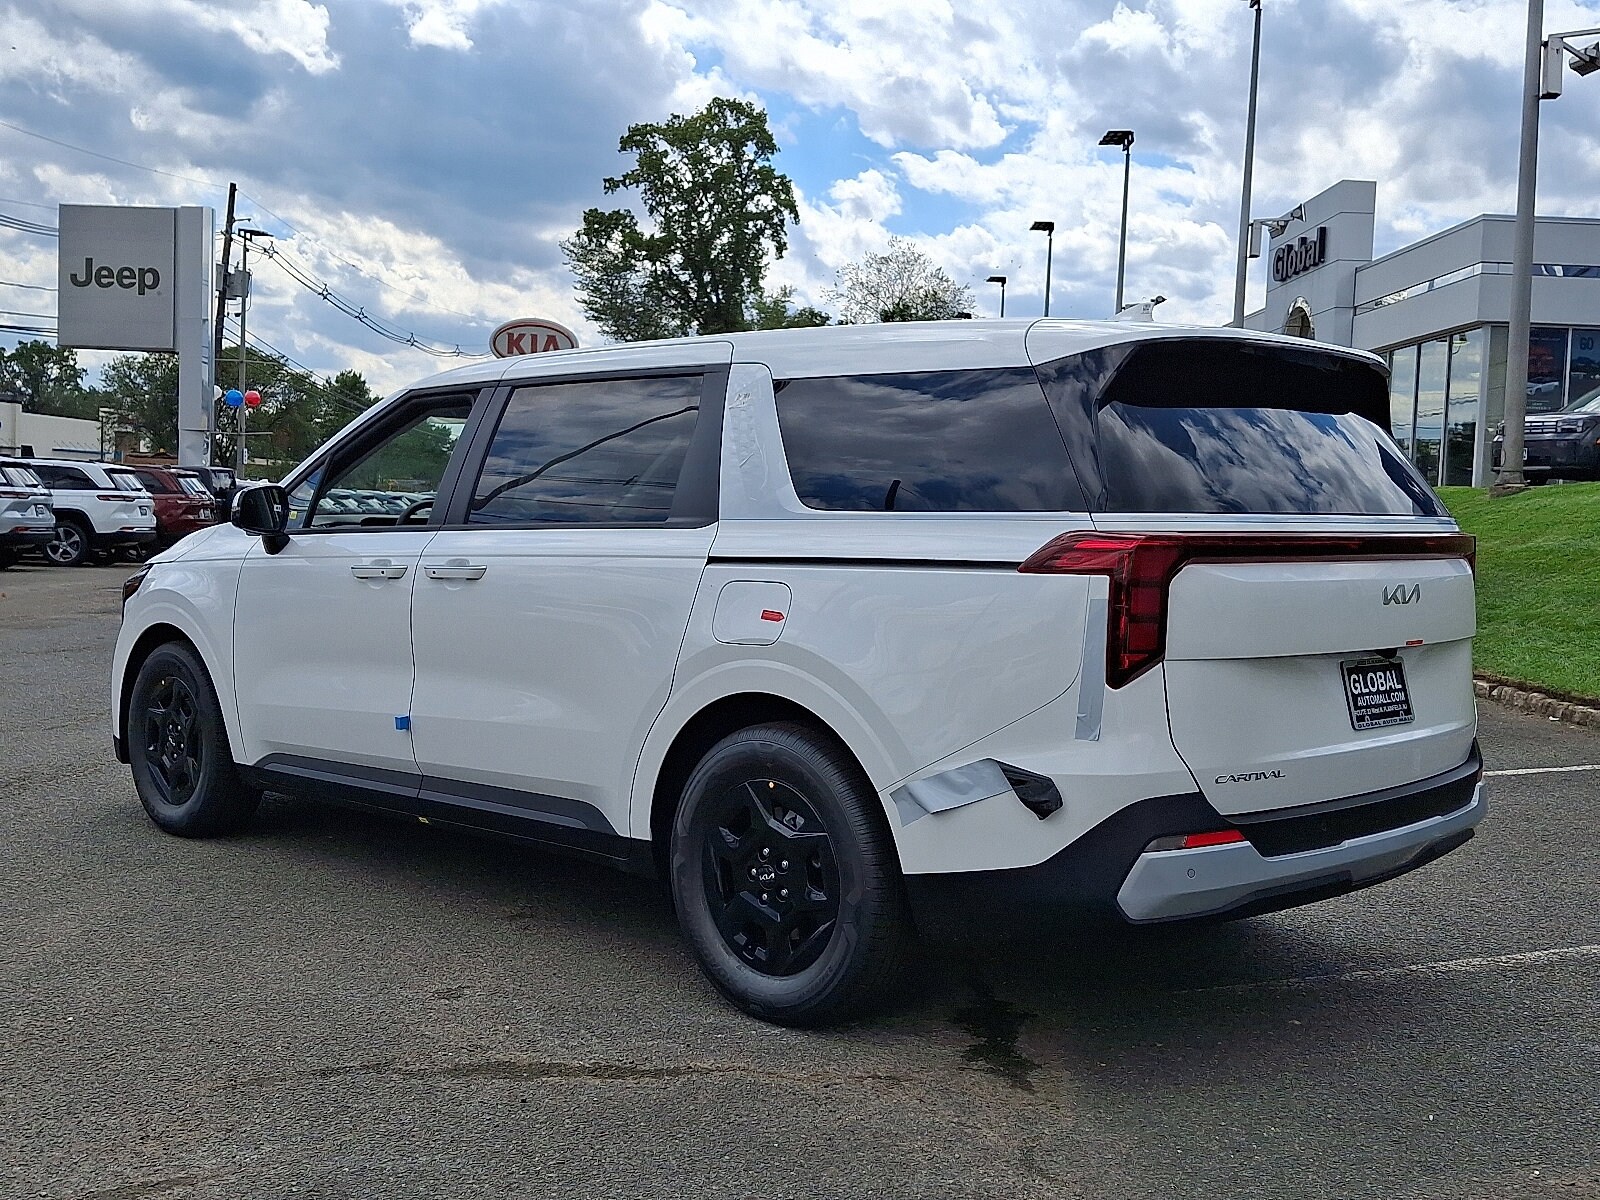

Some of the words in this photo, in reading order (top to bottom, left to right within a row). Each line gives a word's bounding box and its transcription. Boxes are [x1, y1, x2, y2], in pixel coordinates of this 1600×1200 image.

[1273, 226, 1326, 281] Global
[70, 257, 160, 295] Jeep
[506, 332, 560, 355] KIA
[1350, 670, 1402, 694] GLOBAL
[1357, 691, 1406, 706] AUTOMALL.COM
[1215, 769, 1286, 784] CARNIVAL
